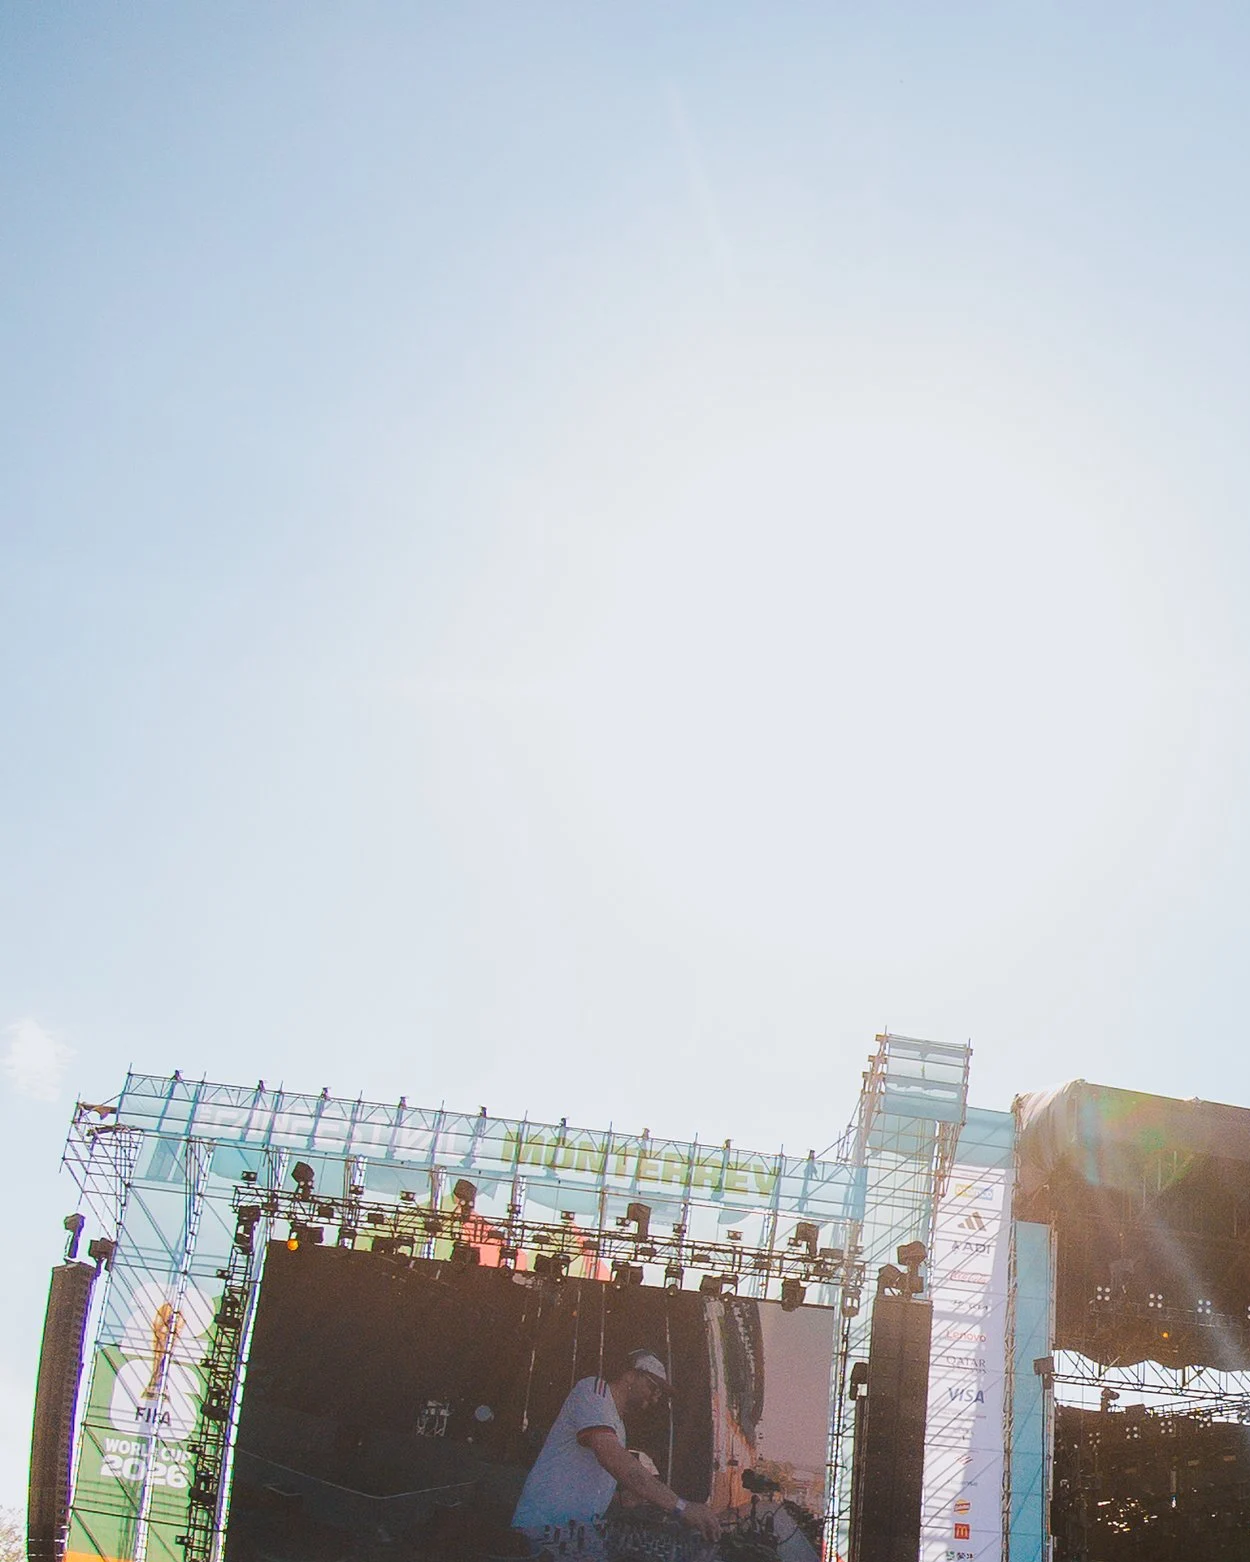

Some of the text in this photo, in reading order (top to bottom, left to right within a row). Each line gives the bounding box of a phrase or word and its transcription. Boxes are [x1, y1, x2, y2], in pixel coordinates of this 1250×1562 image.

[502, 1131, 781, 1196] MONTERREY
[945, 1330, 987, 1342] Lenovo
[946, 1355, 986, 1368] QATAR
[948, 1387, 985, 1403] VISA
[104, 1438, 191, 1463] WORL CUP
[100, 1454, 189, 1488] 2026
